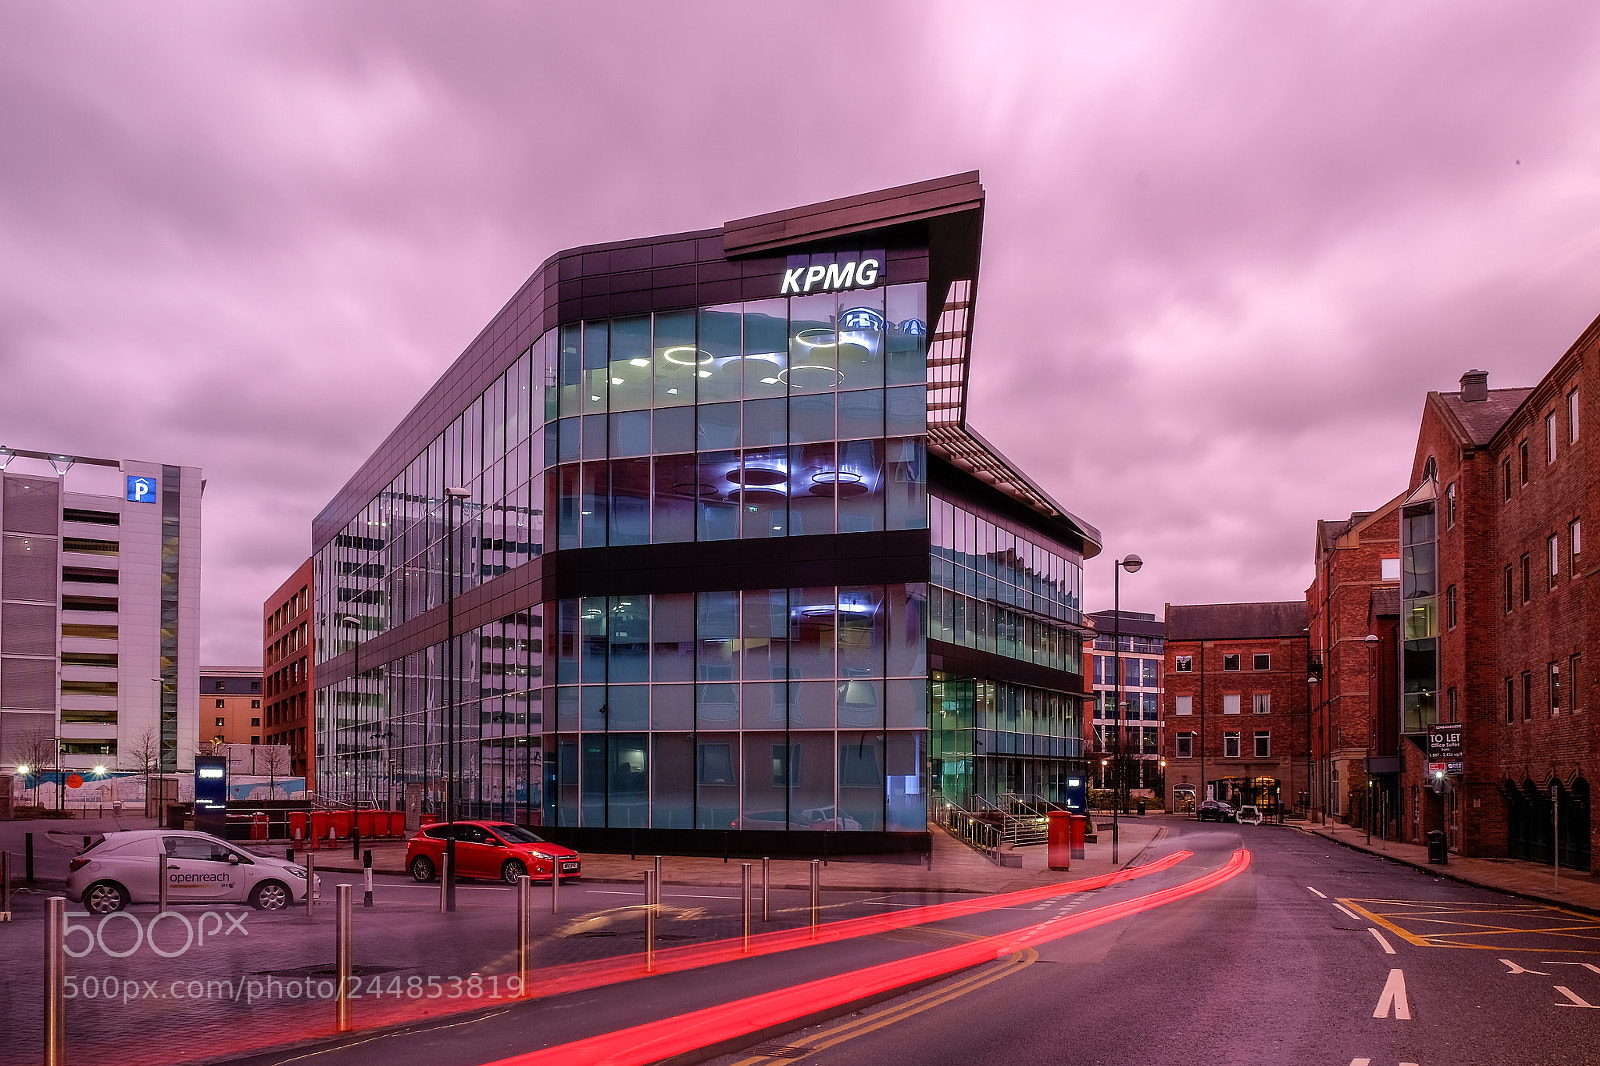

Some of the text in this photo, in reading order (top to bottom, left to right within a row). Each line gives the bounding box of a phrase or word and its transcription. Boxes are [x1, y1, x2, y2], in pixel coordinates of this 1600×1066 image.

[780, 258, 879, 294] KPMG
[135, 483, 149, 501] P
[1430, 733, 1461, 742] TO LET
[170, 872, 230, 883] openreach
